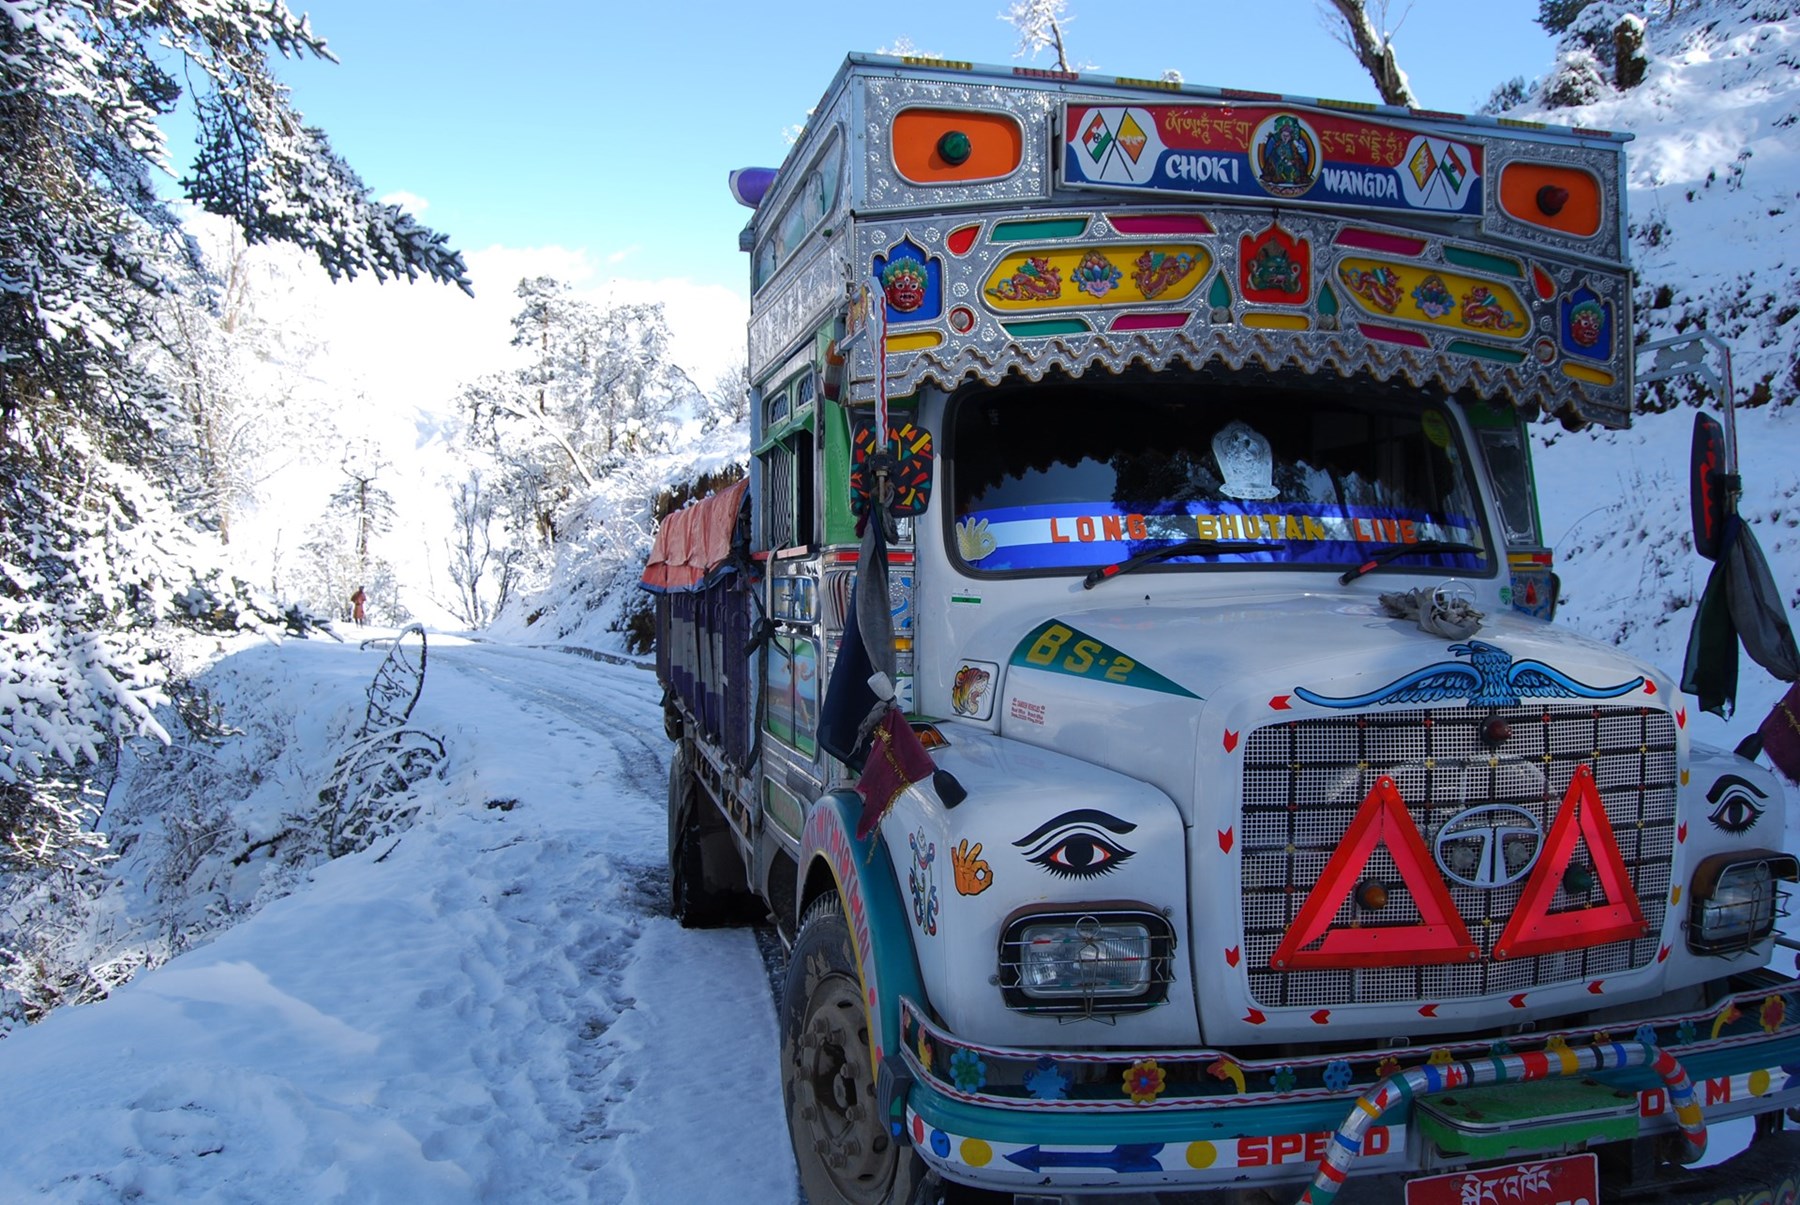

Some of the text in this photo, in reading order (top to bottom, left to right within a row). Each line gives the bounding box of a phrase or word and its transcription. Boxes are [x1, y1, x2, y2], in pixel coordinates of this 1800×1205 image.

[1165, 154, 1398, 200] CHOKI WANGDA
[1050, 513, 1418, 544] LONG BHUTAN LIVE
[1237, 1126, 1389, 1168] SPED
